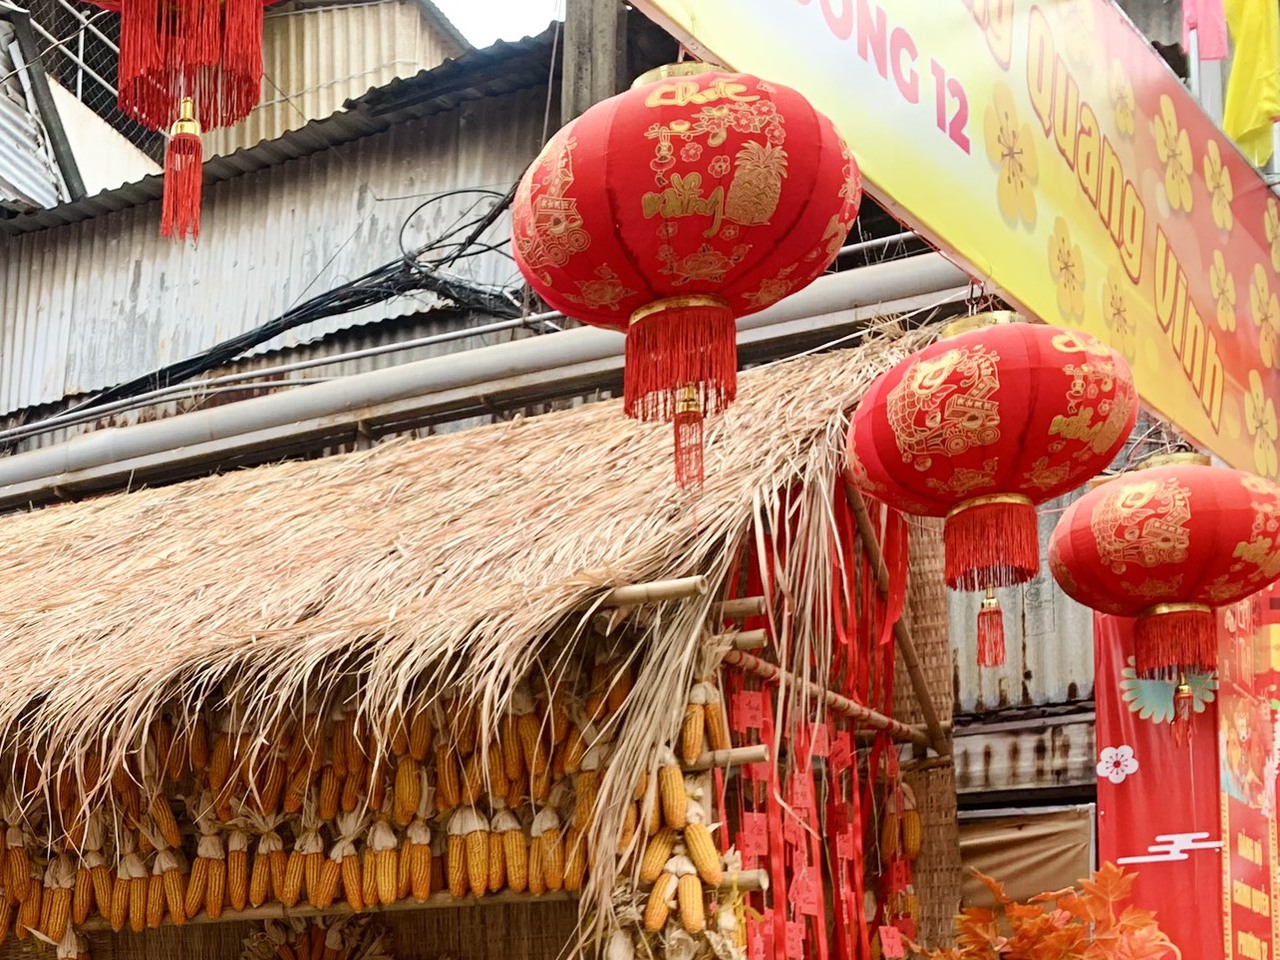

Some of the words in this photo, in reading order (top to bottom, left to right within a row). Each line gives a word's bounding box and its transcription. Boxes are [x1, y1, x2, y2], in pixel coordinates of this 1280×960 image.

[930, 57, 970, 156] 12
[1026, 5, 1146, 284] Quang
[1153, 223, 1224, 436] Vinh
